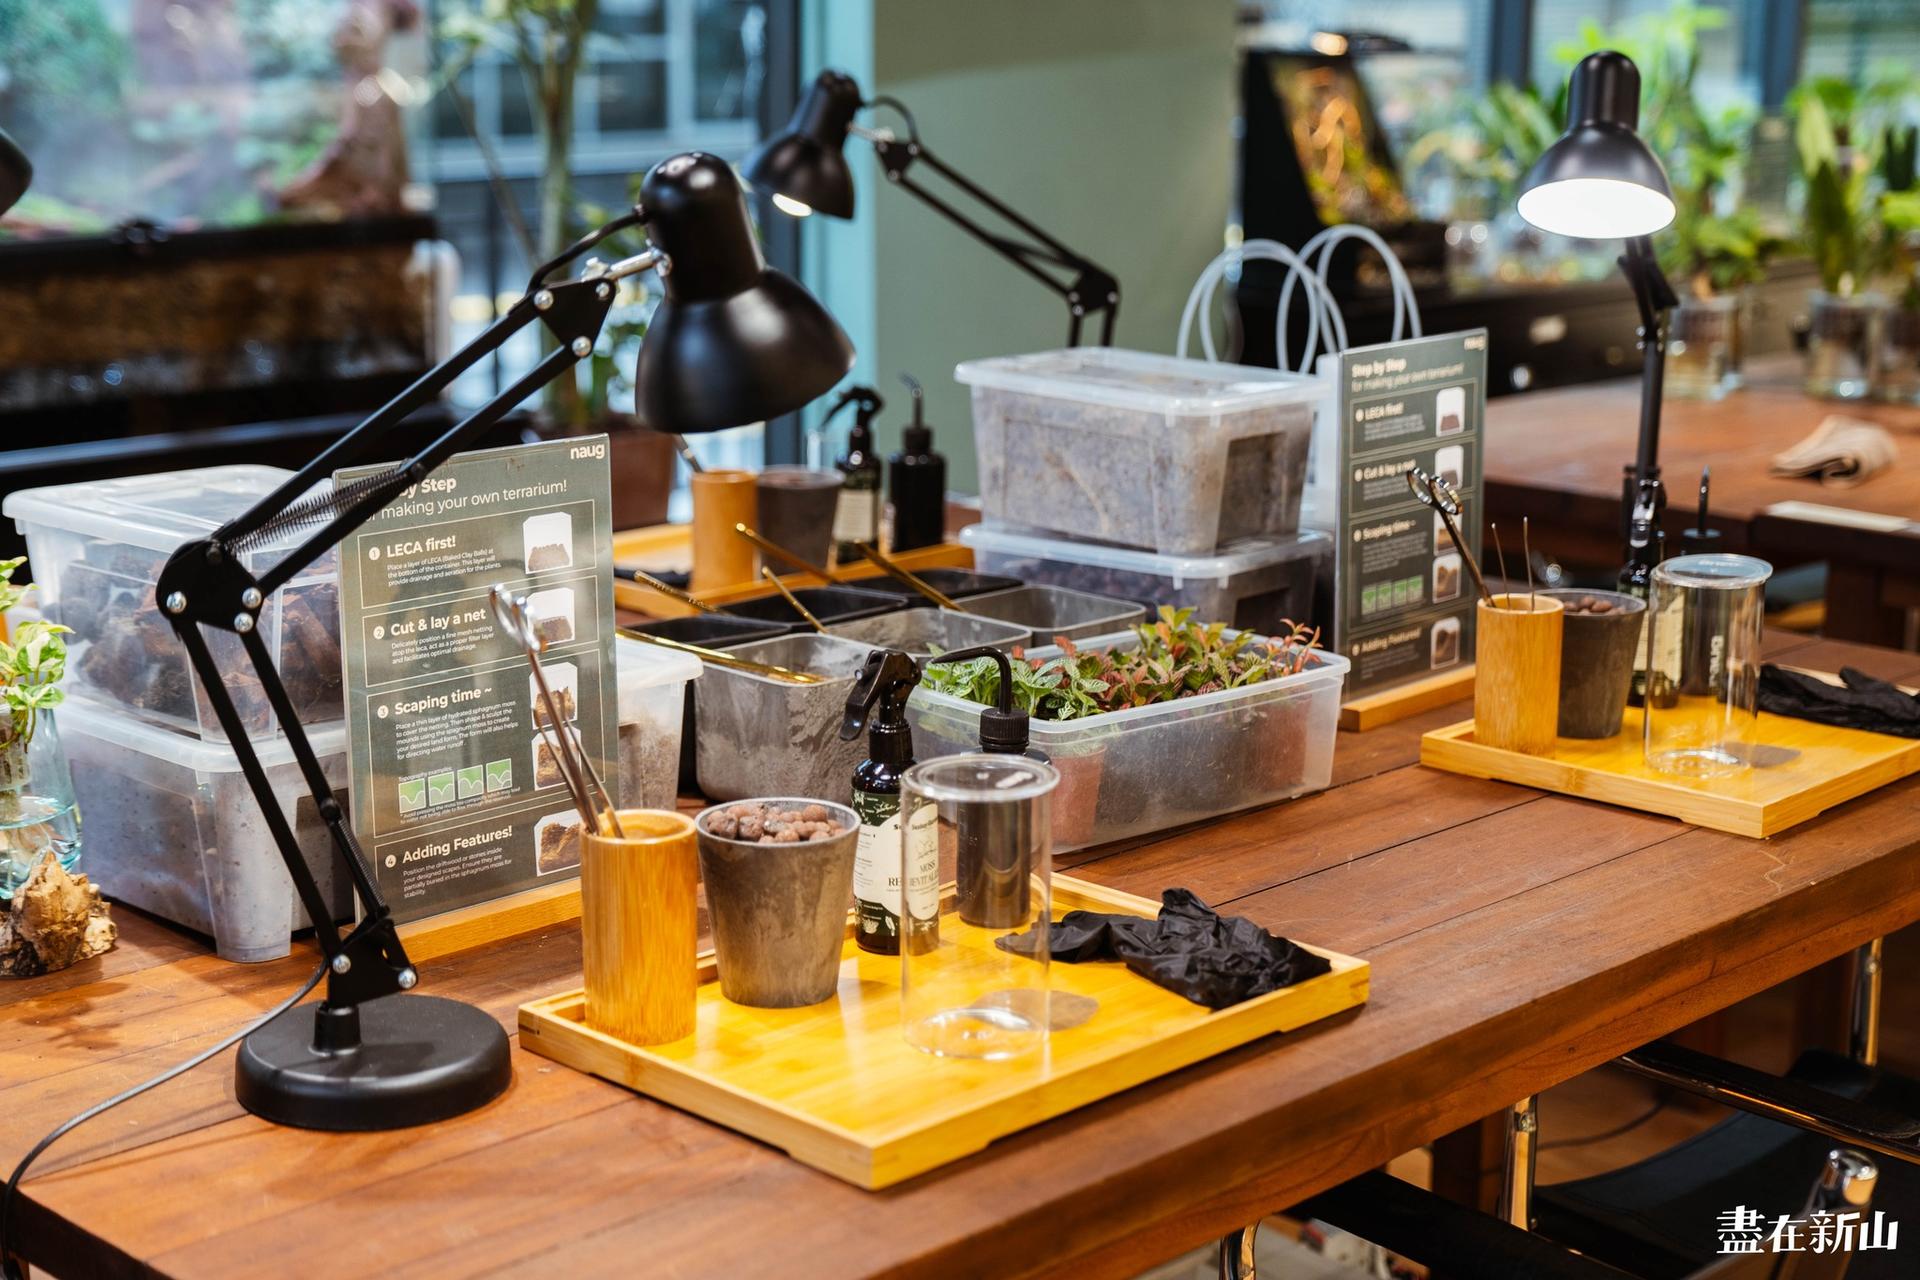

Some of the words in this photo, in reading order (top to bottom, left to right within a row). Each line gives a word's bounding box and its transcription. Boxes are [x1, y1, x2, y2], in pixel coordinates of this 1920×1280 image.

[1352, 364, 1373, 378] Step
[1373, 360, 1385, 375] by
[1385, 358, 1407, 372] Step
[570, 444, 605, 460] naug
[421, 478, 457, 493] Step
[382, 501, 434, 519] making
[437, 496, 468, 514] your
[471, 492, 500, 506] own
[503, 479, 567, 501] terrarium!
[387, 539, 423, 558] LECA
[425, 534, 456, 551] first!
[390, 621, 415, 636] Cut
[418, 618, 428, 631] &
[431, 616, 450, 630] lay
[453, 614, 461, 625] a
[464, 608, 486, 623] net
[395, 695, 448, 715] Scaping
[451, 689, 481, 704] time
[402, 844, 450, 864] Adding
[454, 825, 512, 851] Features!
